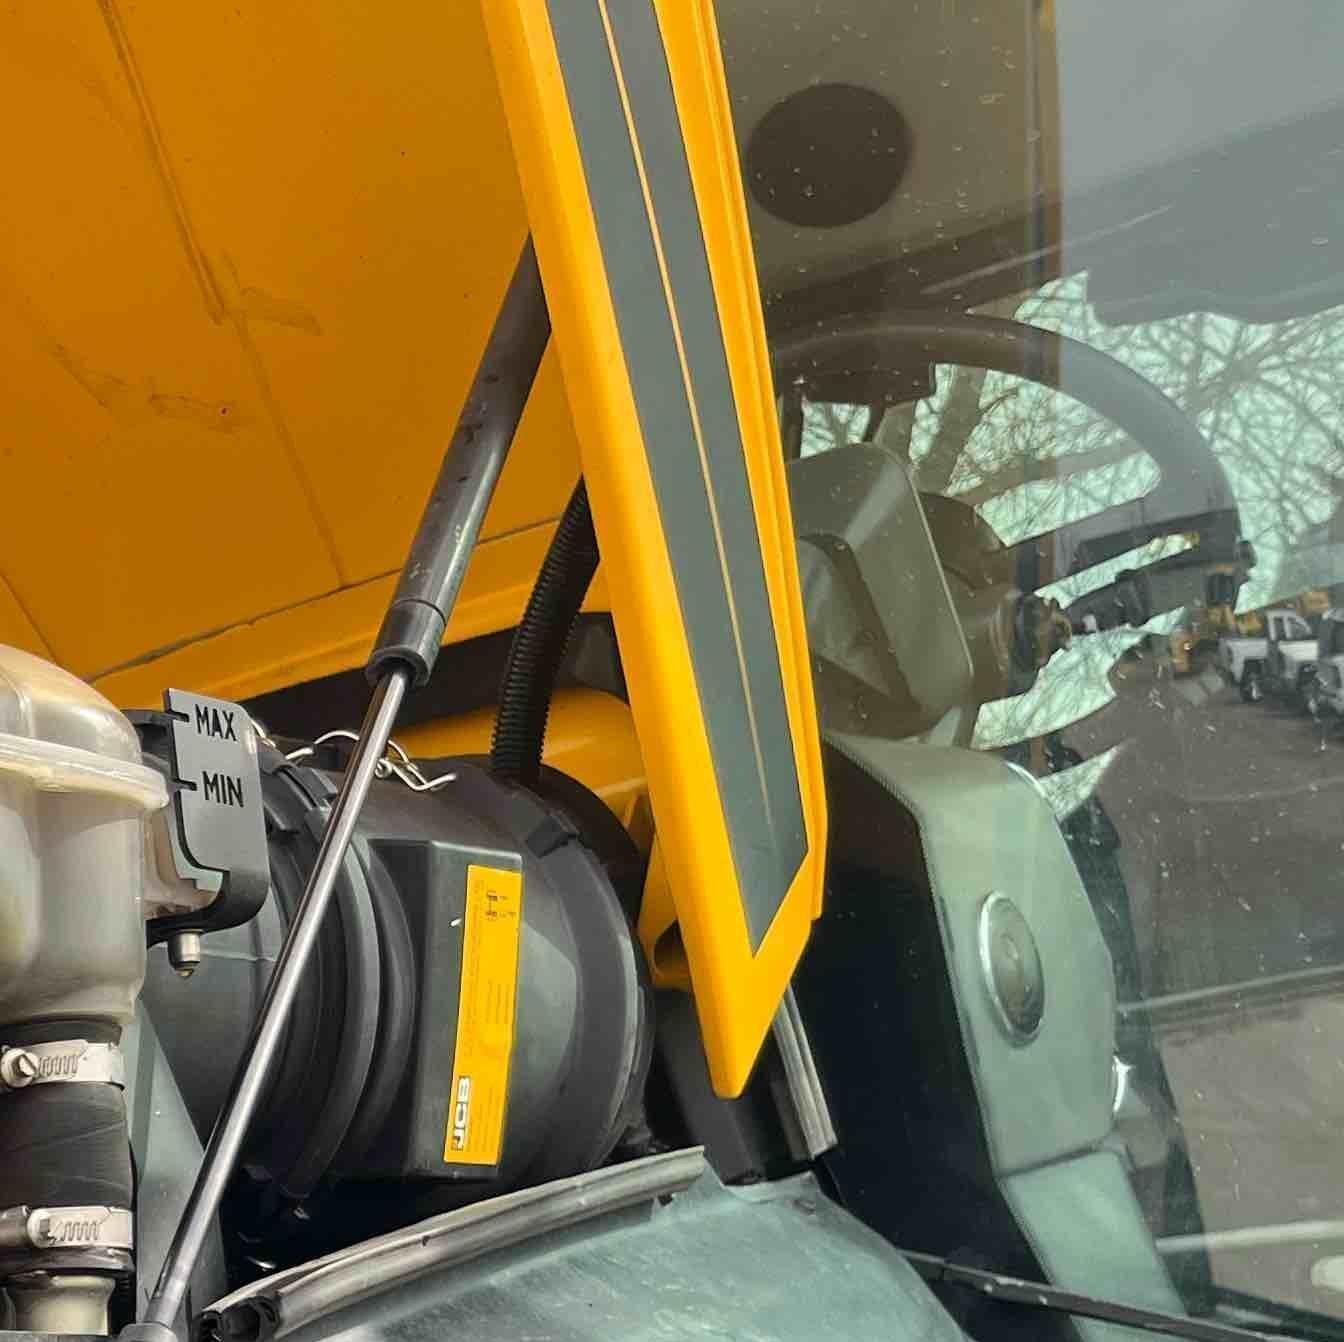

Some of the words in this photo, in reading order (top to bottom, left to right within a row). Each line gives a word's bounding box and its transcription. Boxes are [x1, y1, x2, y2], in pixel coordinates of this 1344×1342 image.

[195, 703, 239, 743] MAX
[202, 769, 245, 808] MIN
[451, 1075, 473, 1152] JCB
